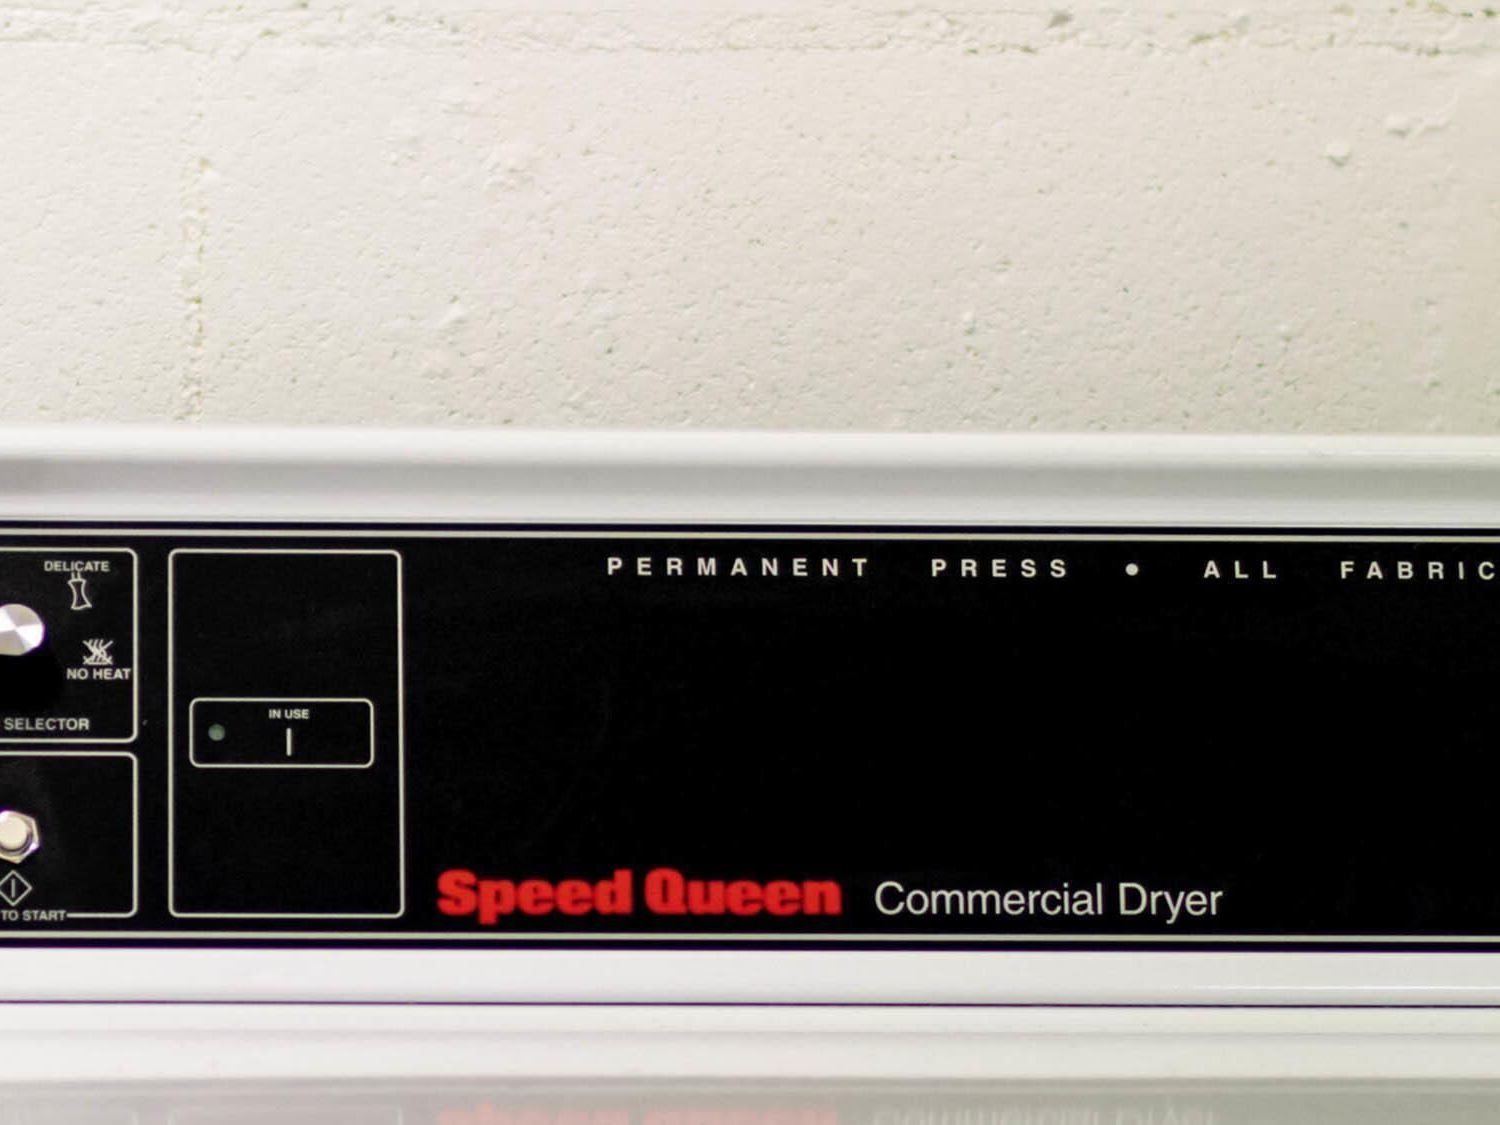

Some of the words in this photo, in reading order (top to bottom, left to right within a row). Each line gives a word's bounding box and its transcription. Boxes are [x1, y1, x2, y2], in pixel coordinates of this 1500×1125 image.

[43, 560, 111, 572] DELICATE
[606, 556, 869, 577] PERMANENT
[930, 558, 1068, 578] PRESS
[1202, 560, 1278, 579] ALL
[1339, 560, 1496, 580] FABRIC
[66, 667, 89, 680] NO
[92, 667, 131, 680] HEAT
[268, 709, 282, 719] IN
[284, 708, 309, 720] USE
[4, 717, 90, 731] SELECTOR
[437, 868, 633, 925] Speed
[644, 867, 842, 916] Queen
[874, 880, 1104, 917] Commercial
[1117, 882, 1225, 925] Dryer
[0, 909, 19, 921] TO
[21, 909, 66, 921] START
